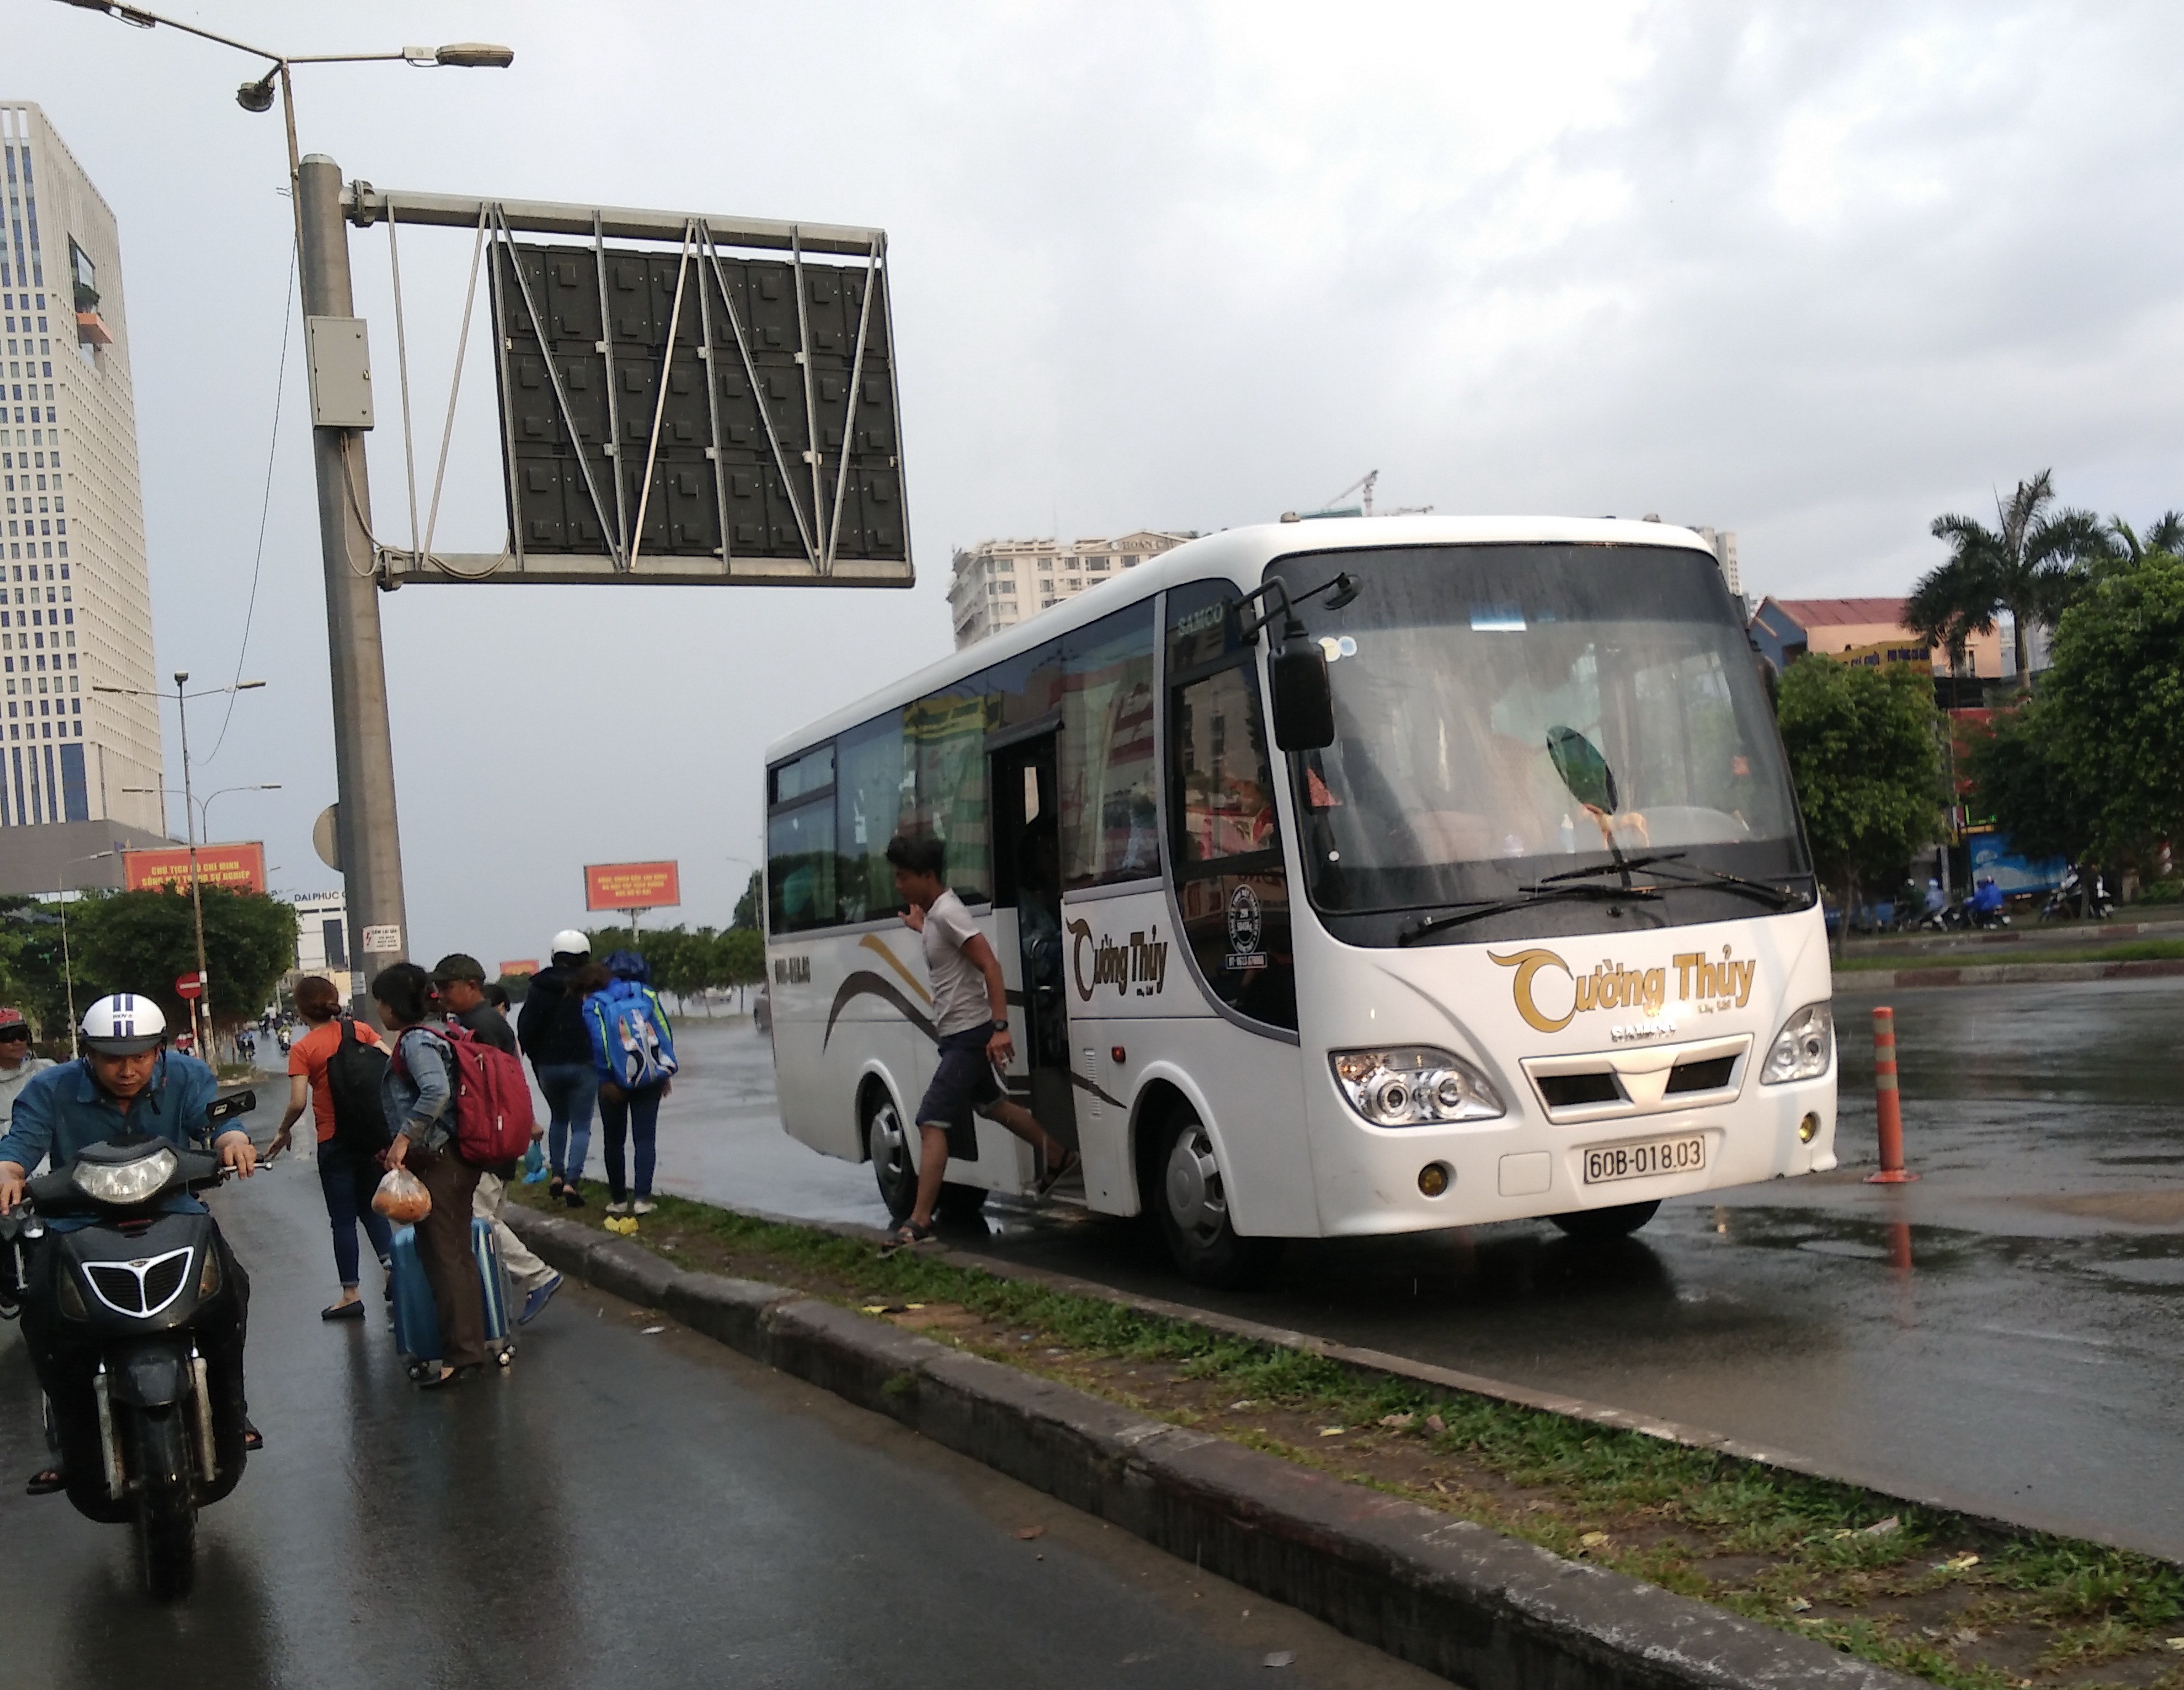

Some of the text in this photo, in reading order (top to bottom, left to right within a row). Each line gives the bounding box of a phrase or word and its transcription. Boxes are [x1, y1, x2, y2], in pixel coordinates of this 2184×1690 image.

[1065, 916, 1129, 1003] Cường
[1487, 948, 1666, 1033] Cường
[1590, 1140, 1701, 1179] 60B-018.03
